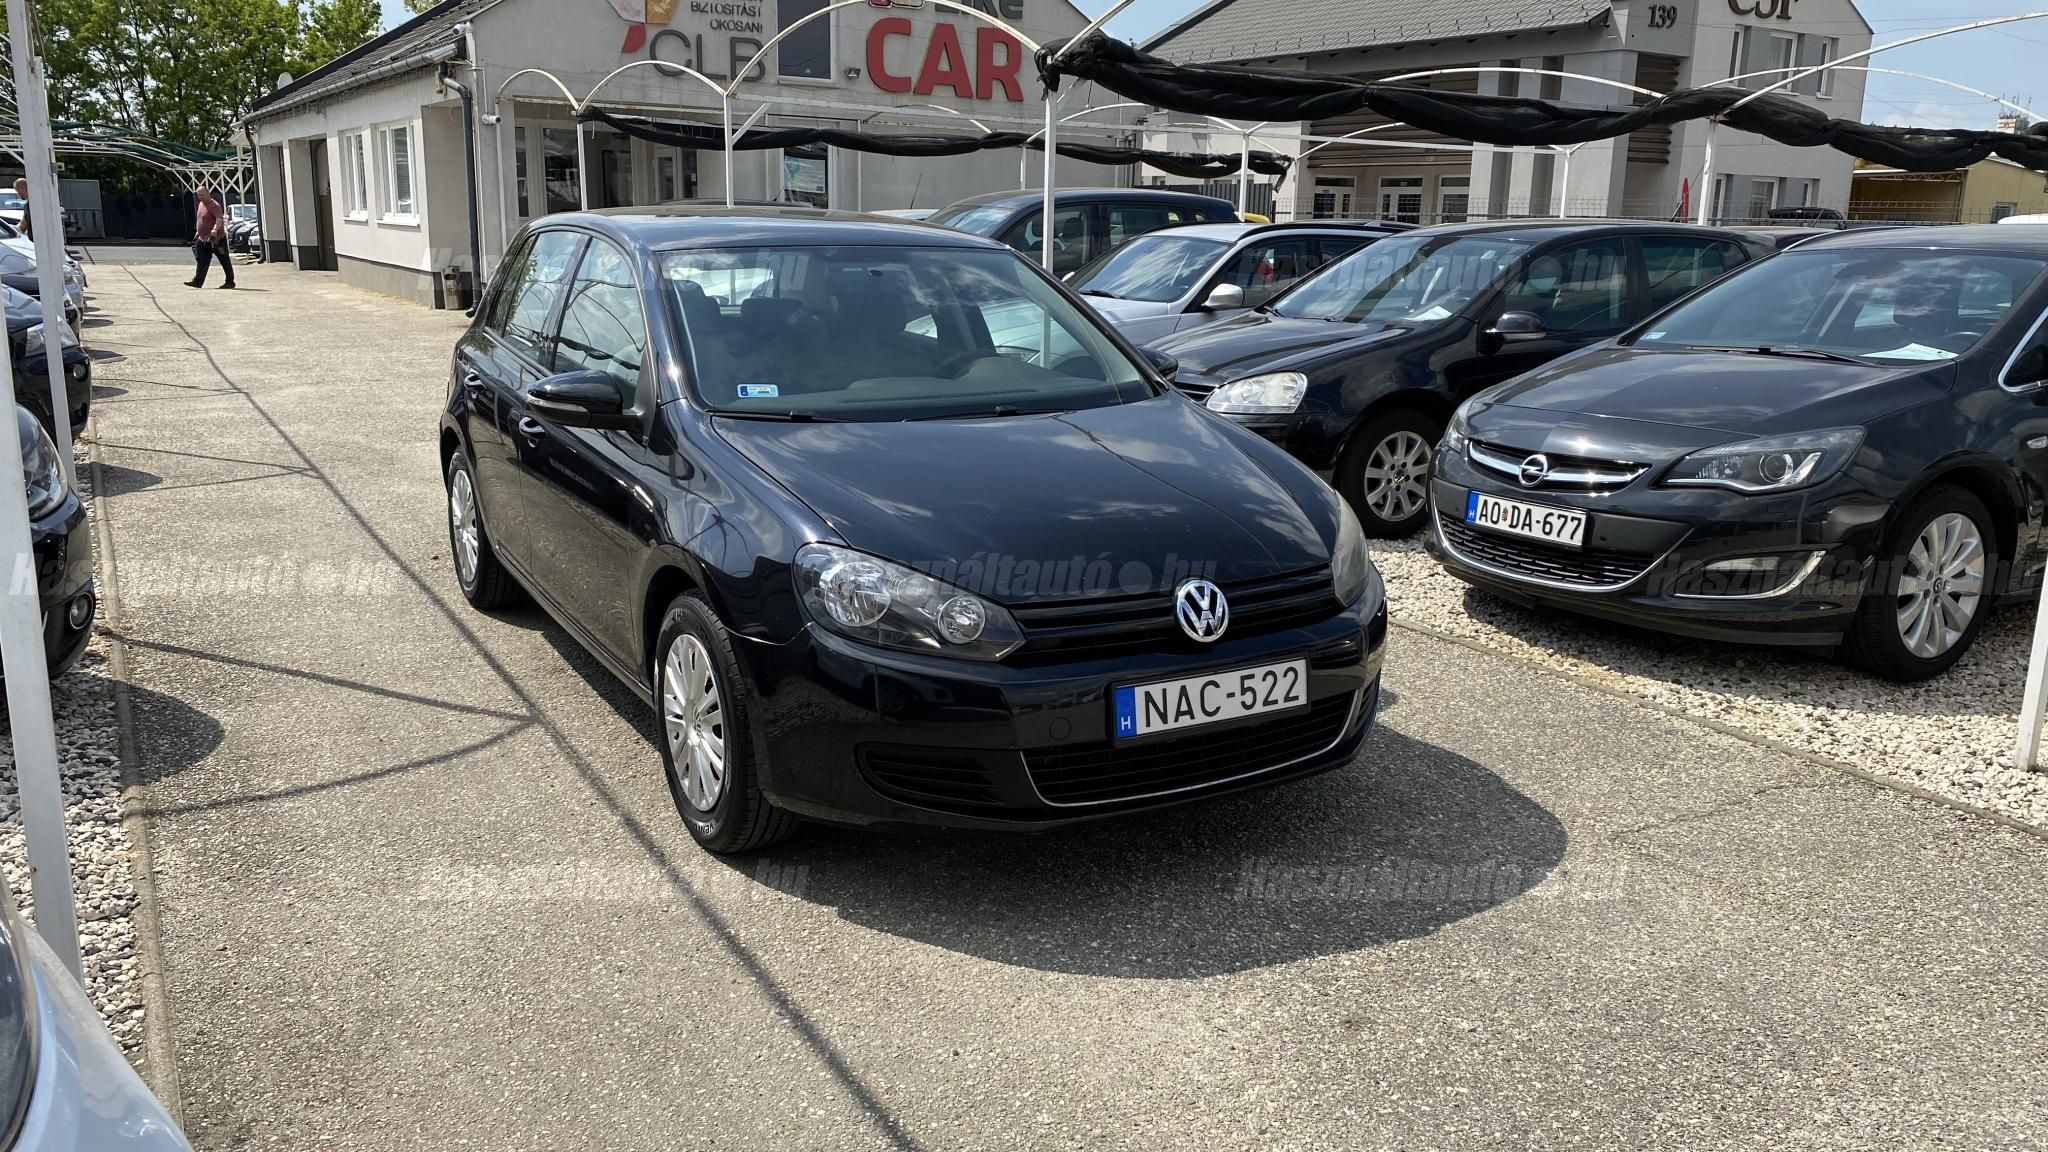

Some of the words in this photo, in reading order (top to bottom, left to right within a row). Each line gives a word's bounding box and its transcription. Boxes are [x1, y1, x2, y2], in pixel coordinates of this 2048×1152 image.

[1647, 4, 1678, 28] 139
[649, 29, 766, 82] CLB
[865, 17, 1025, 102] CAR
[1478, 498, 1501, 525] AO
[1508, 504, 1583, 540] DA-677
[1120, 715, 1132, 731] H
[1144, 665, 1300, 728] NAC-522
